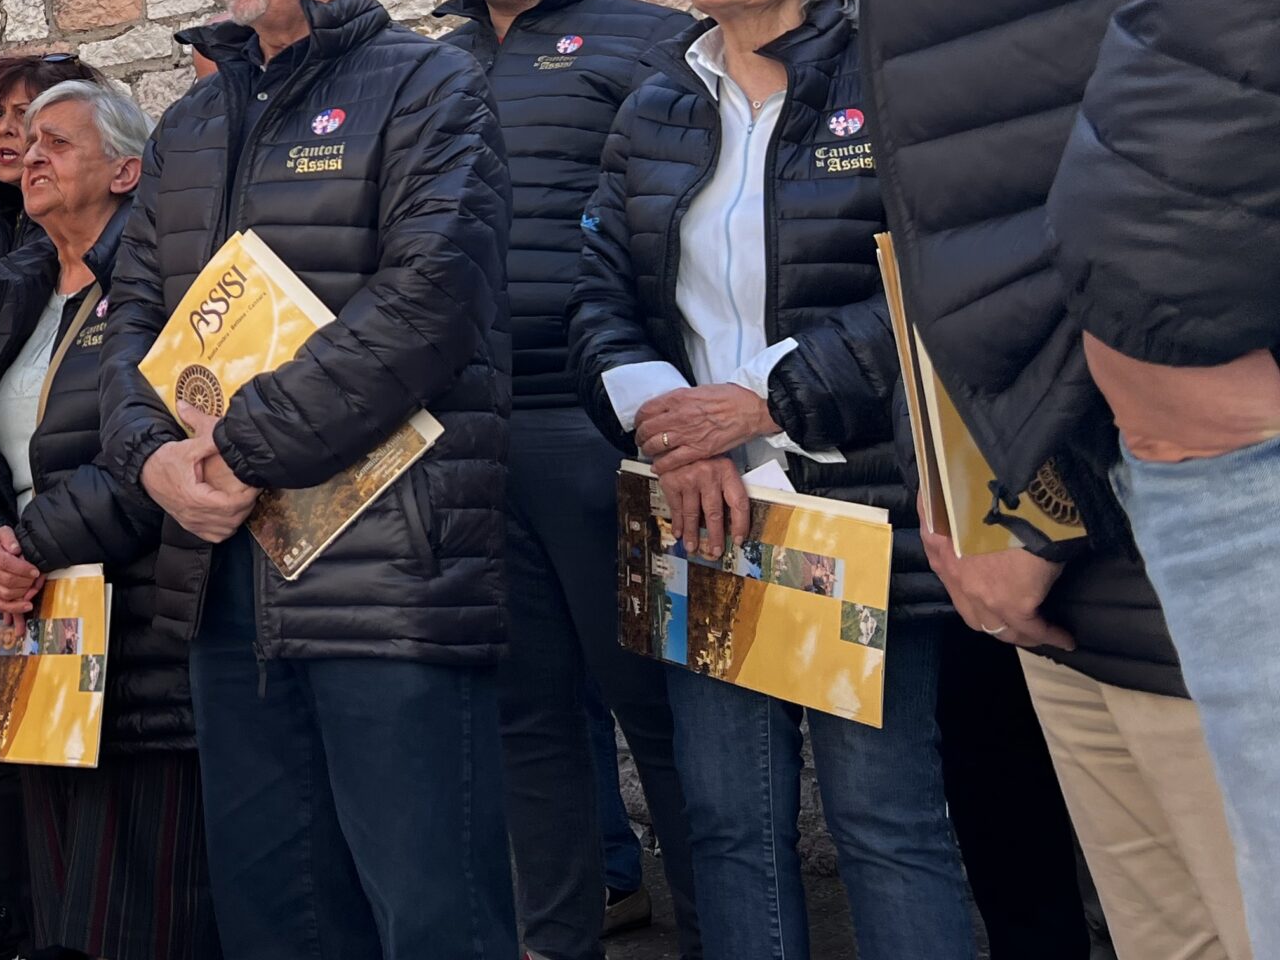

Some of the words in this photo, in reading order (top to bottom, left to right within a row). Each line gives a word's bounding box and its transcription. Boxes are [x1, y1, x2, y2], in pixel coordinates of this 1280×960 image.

[289, 142, 345, 158] Cantori
[815, 143, 871, 158] Cantor
[295, 156, 342, 173] Assisi
[816, 160, 825, 168] di
[189, 264, 248, 357] ASSISI
